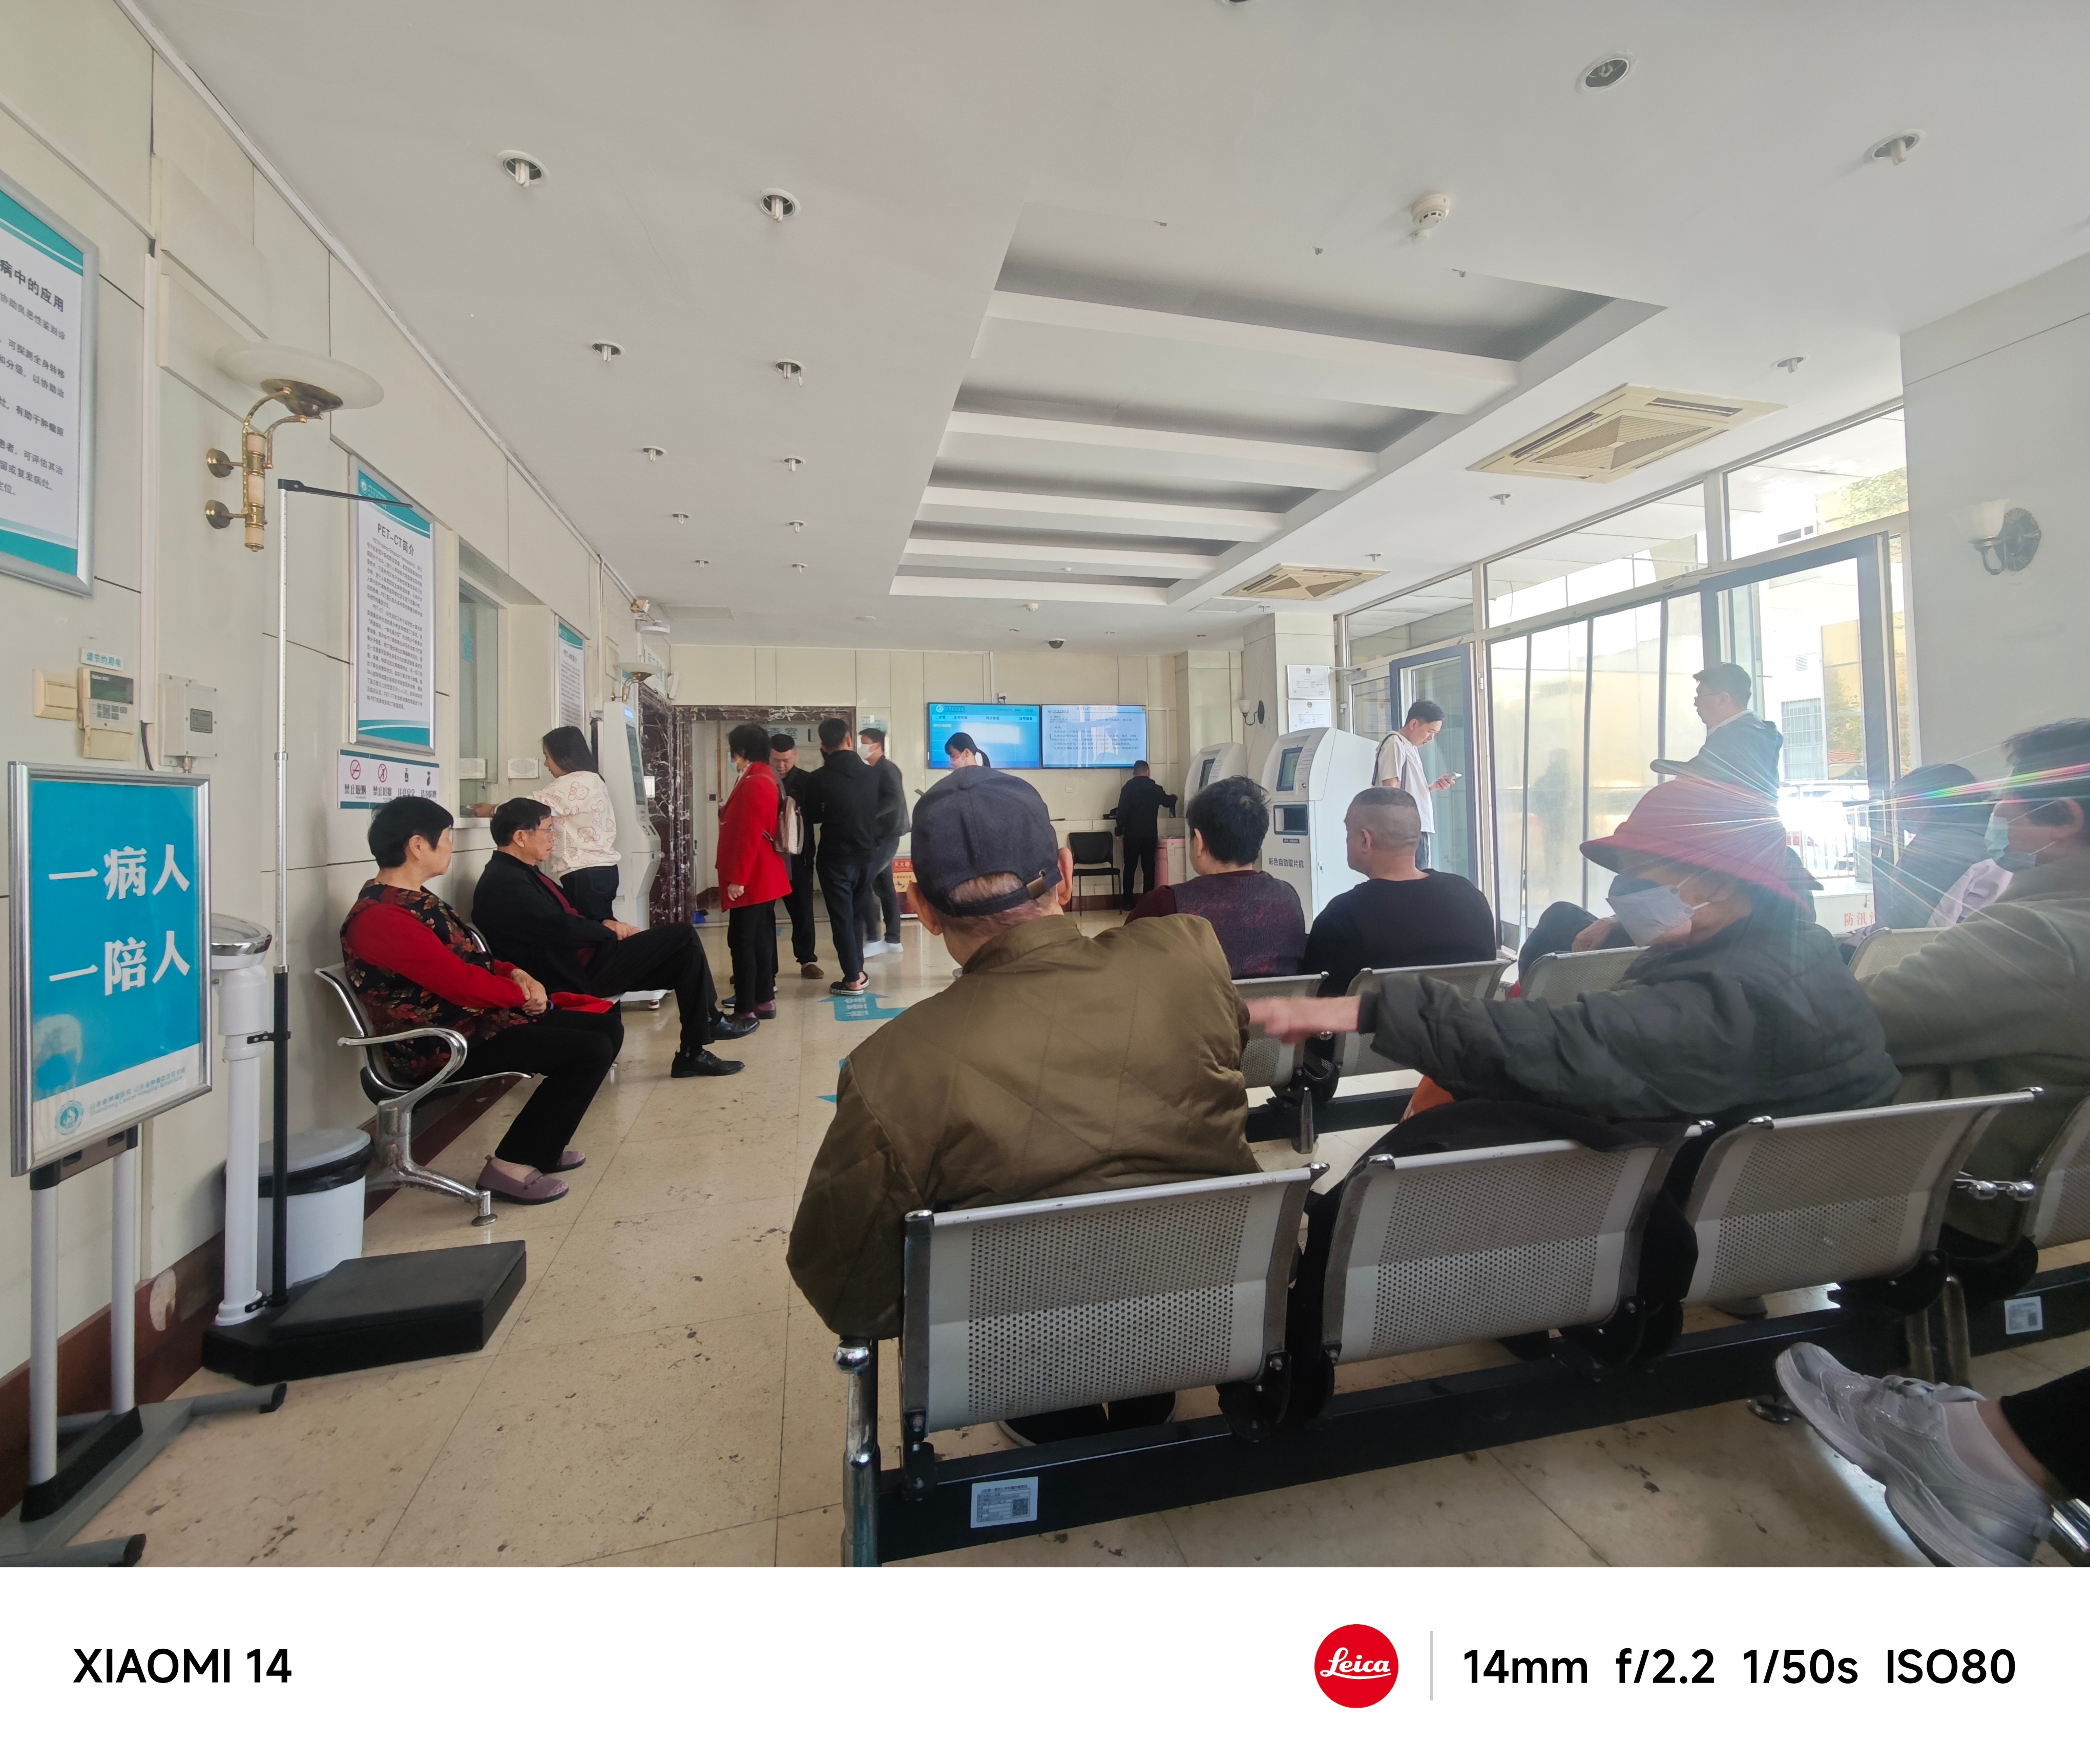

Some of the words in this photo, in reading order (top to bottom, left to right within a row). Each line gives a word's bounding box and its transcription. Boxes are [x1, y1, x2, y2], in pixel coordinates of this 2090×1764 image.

[378, 523, 414, 557] PET-CT简介
[87, 652, 121, 667] 请节约用电
[344, 784, 366, 795] 禁止吸烟
[48, 844, 190, 900] 一病人
[1268, 857, 1304, 869] 彩色自助取片机
[49, 930, 191, 996] 一陪人
